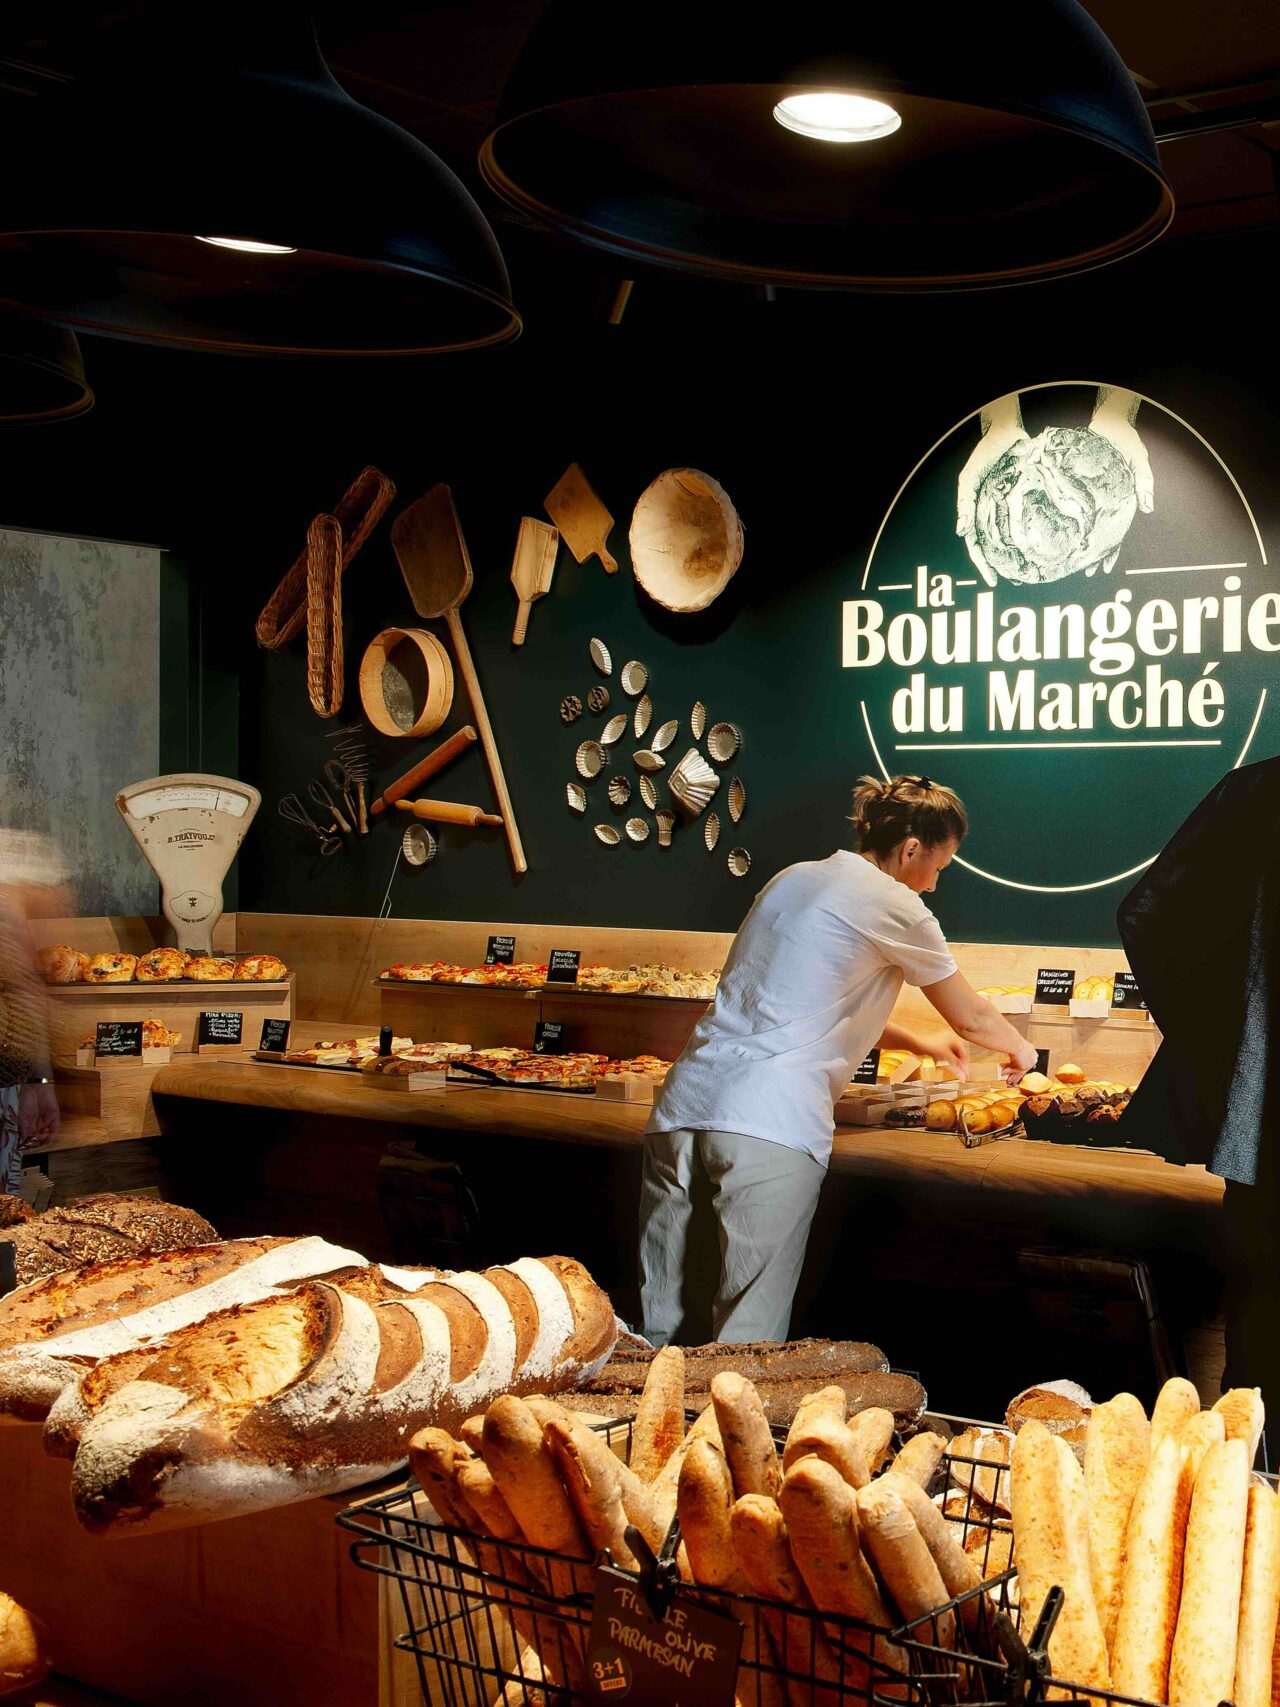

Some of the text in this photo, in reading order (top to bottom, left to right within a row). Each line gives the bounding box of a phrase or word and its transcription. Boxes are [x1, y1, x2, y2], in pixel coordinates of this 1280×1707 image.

[917, 565, 956, 608] la
[891, 661, 1225, 734] du Marché
[607, 1617, 695, 1678] PARMESAN
[665, 1631, 716, 1661] OLIVE
[593, 1657, 623, 1679] 3+1
